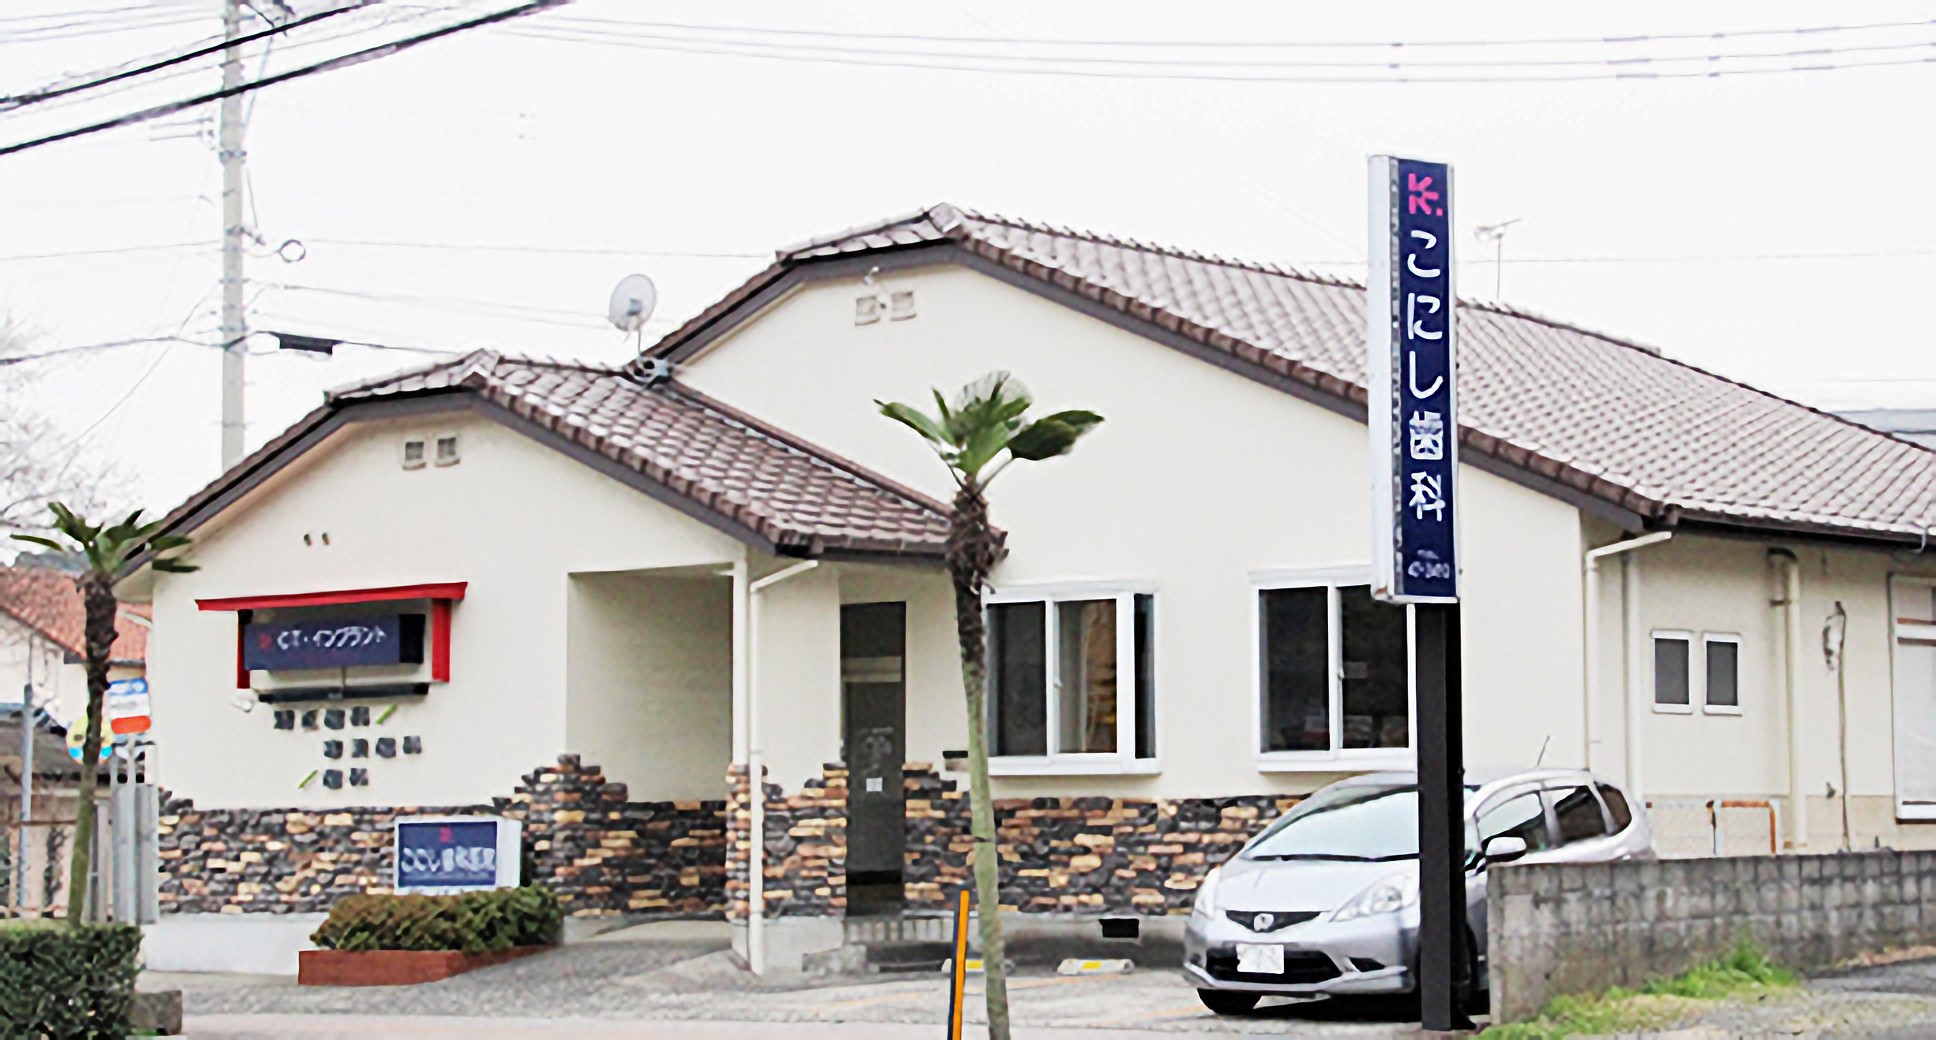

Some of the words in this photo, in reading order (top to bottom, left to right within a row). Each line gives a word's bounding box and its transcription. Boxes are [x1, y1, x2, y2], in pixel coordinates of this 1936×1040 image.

[1407, 229, 1447, 522] こにし歯科
